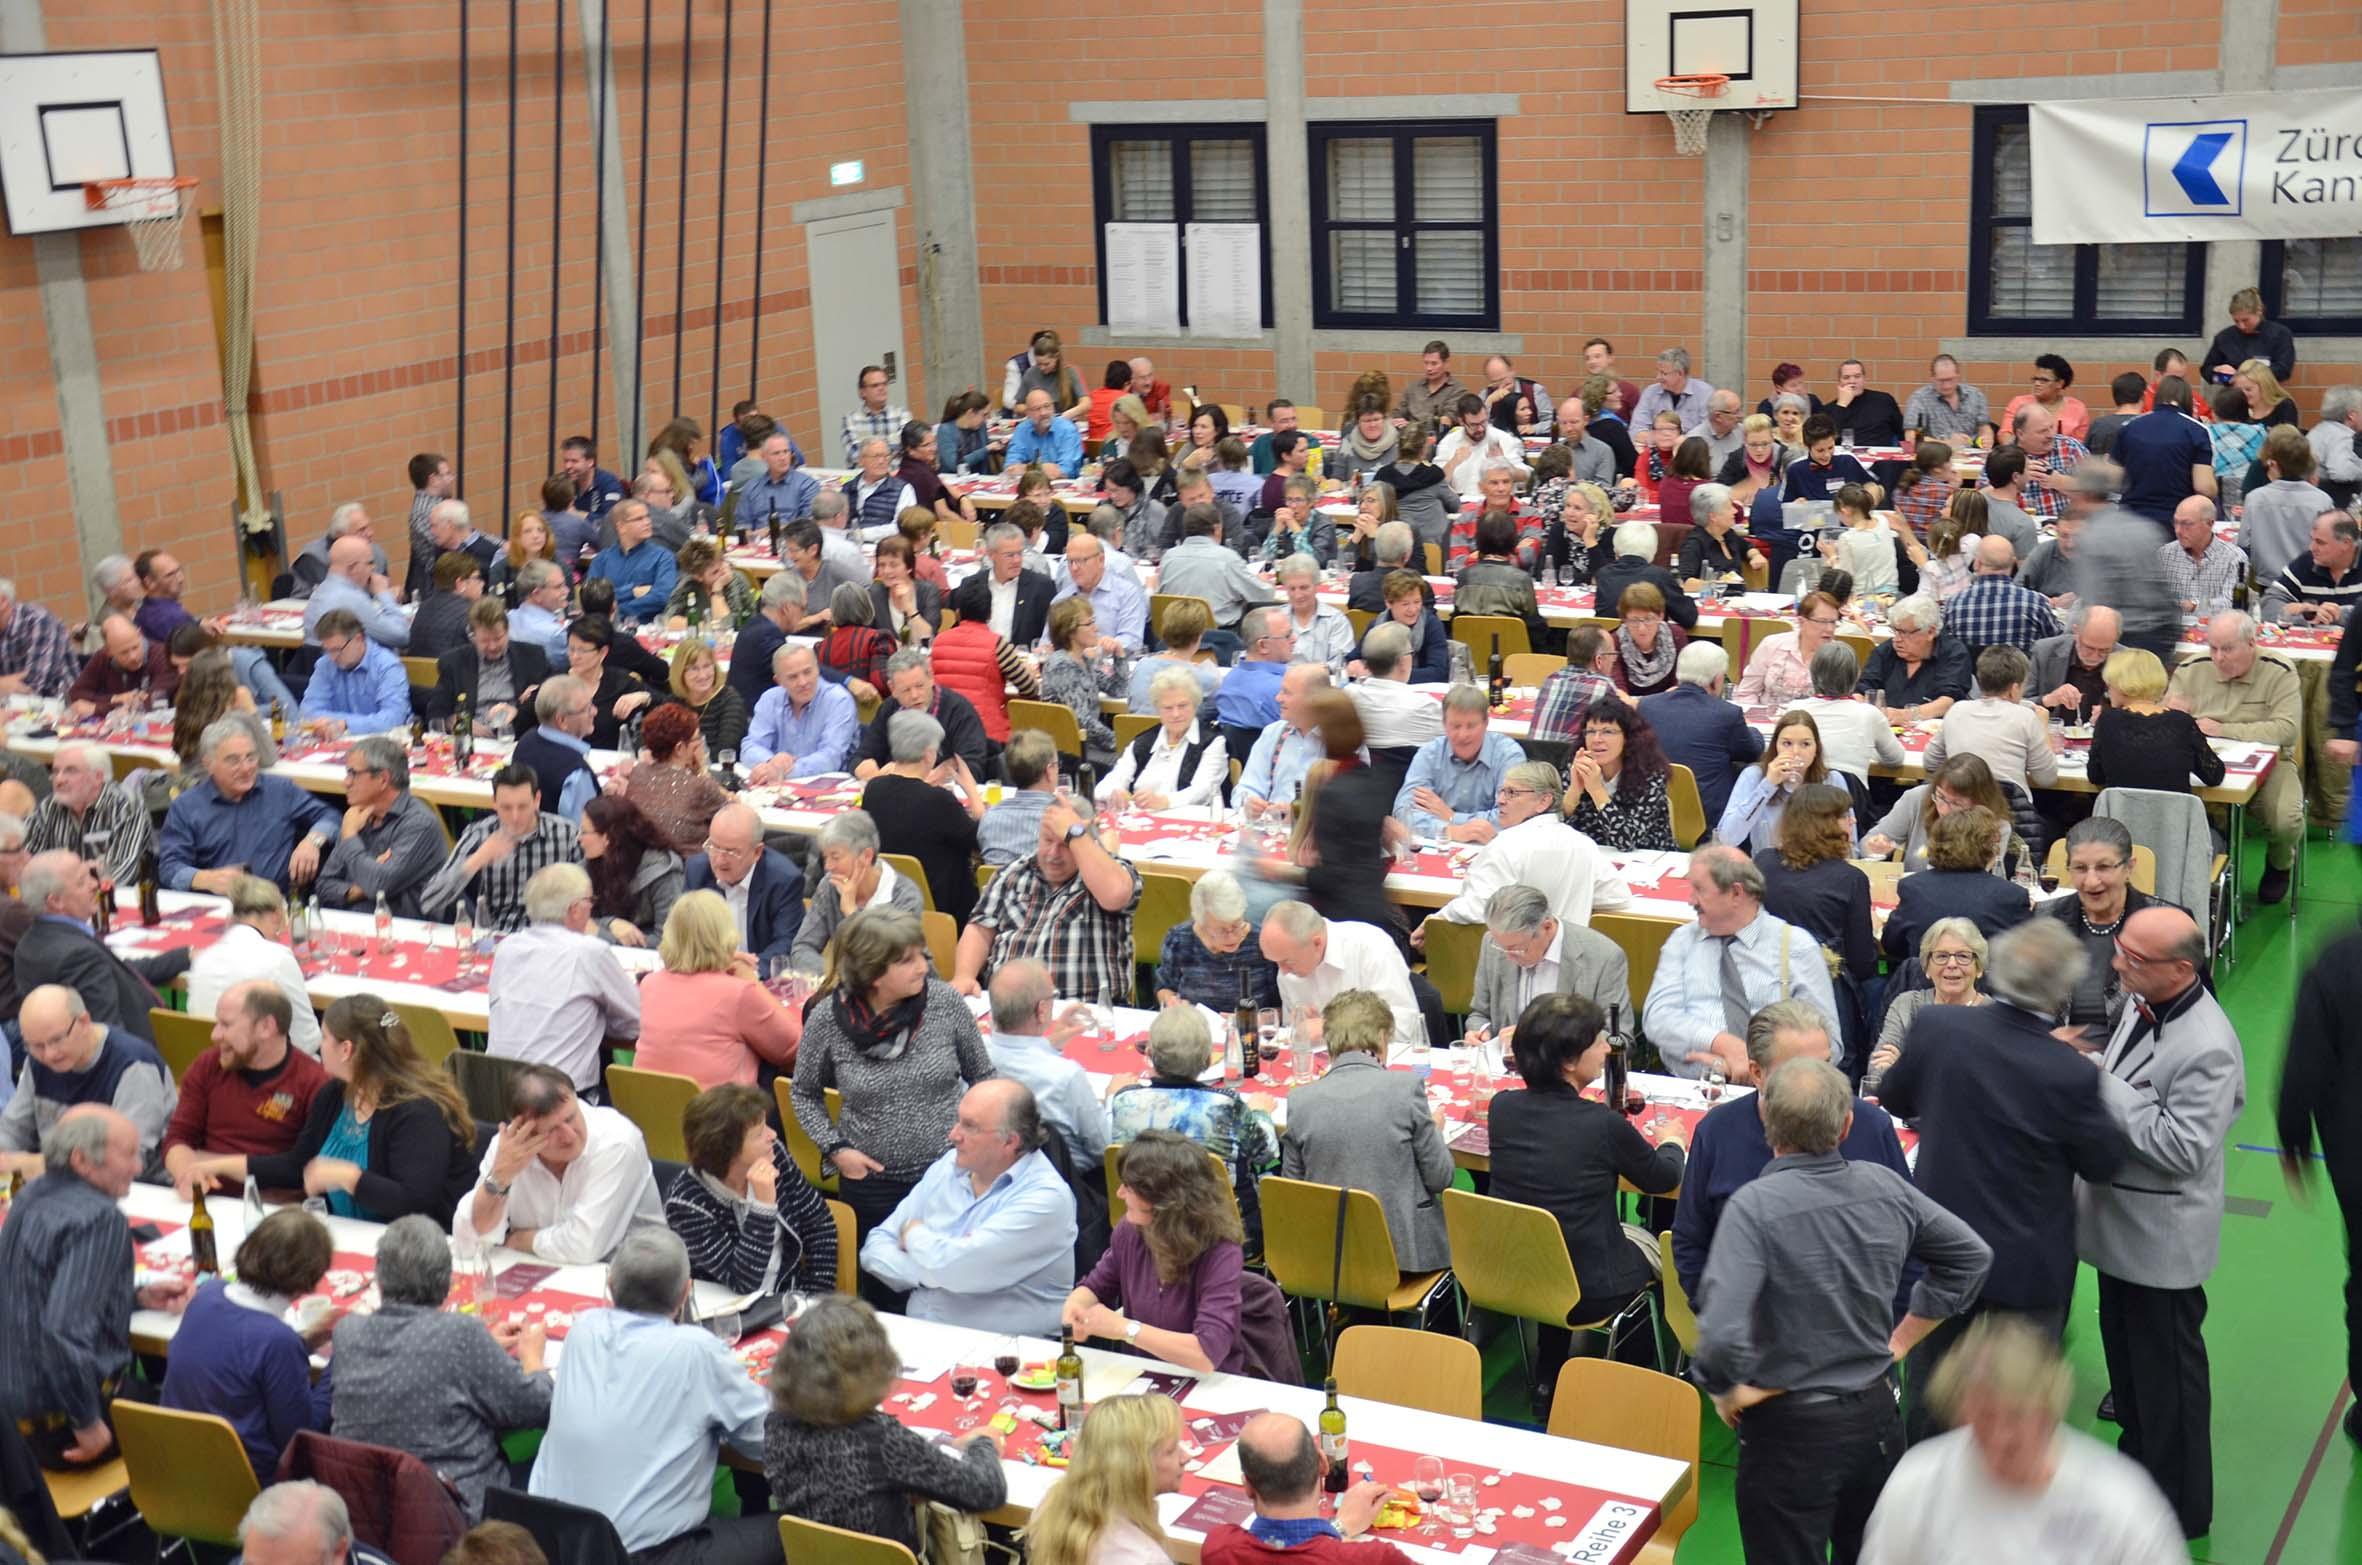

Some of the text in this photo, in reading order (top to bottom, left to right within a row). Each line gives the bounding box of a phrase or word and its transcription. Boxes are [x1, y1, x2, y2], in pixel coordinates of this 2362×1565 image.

[2272, 170, 2362, 204] Kan
[1572, 1505, 1637, 1563] Reihe 3
